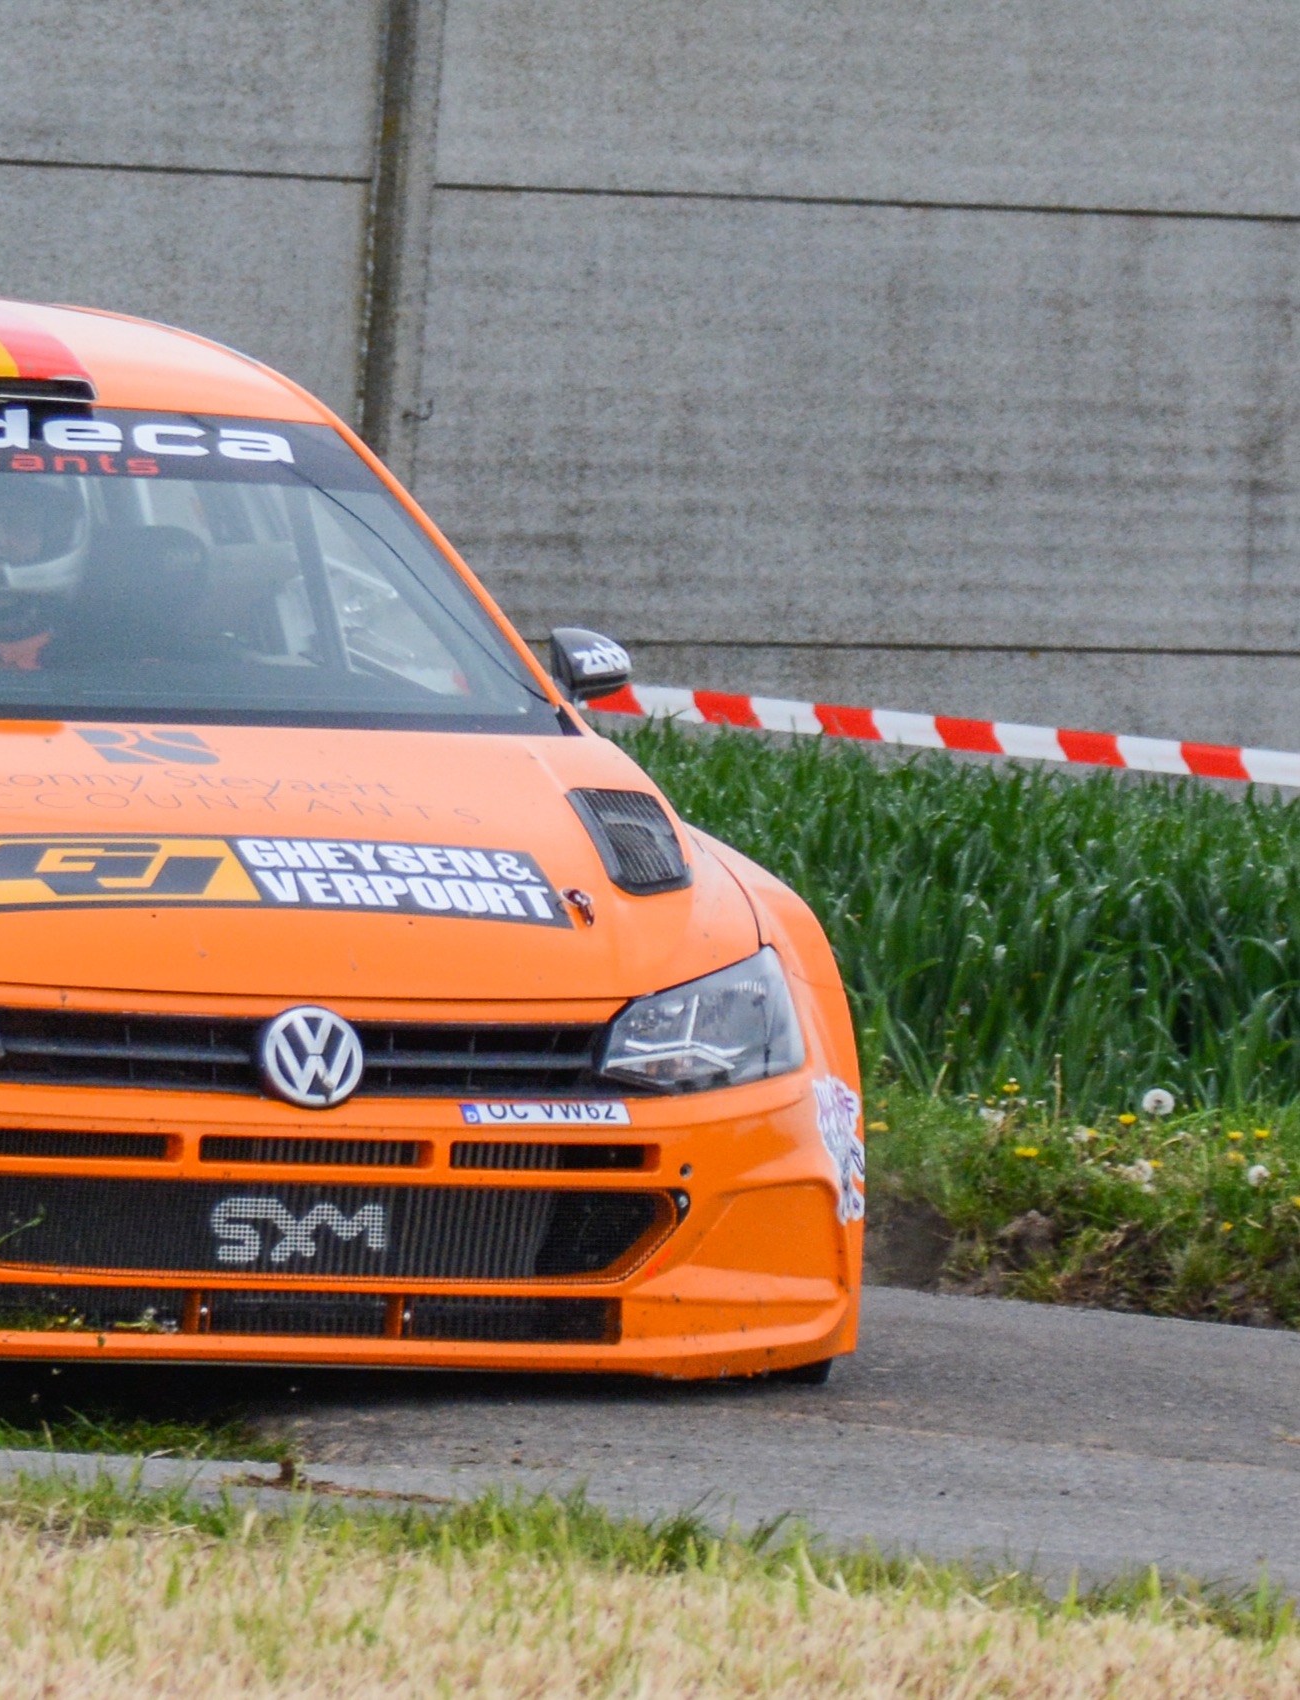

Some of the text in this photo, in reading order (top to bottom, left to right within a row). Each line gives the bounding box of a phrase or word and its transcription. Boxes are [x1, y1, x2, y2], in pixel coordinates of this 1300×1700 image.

[163, 769, 400, 798] Steyaert
[254, 869, 555, 920] VERPOORT
[266, 1006, 363, 1104] VW
